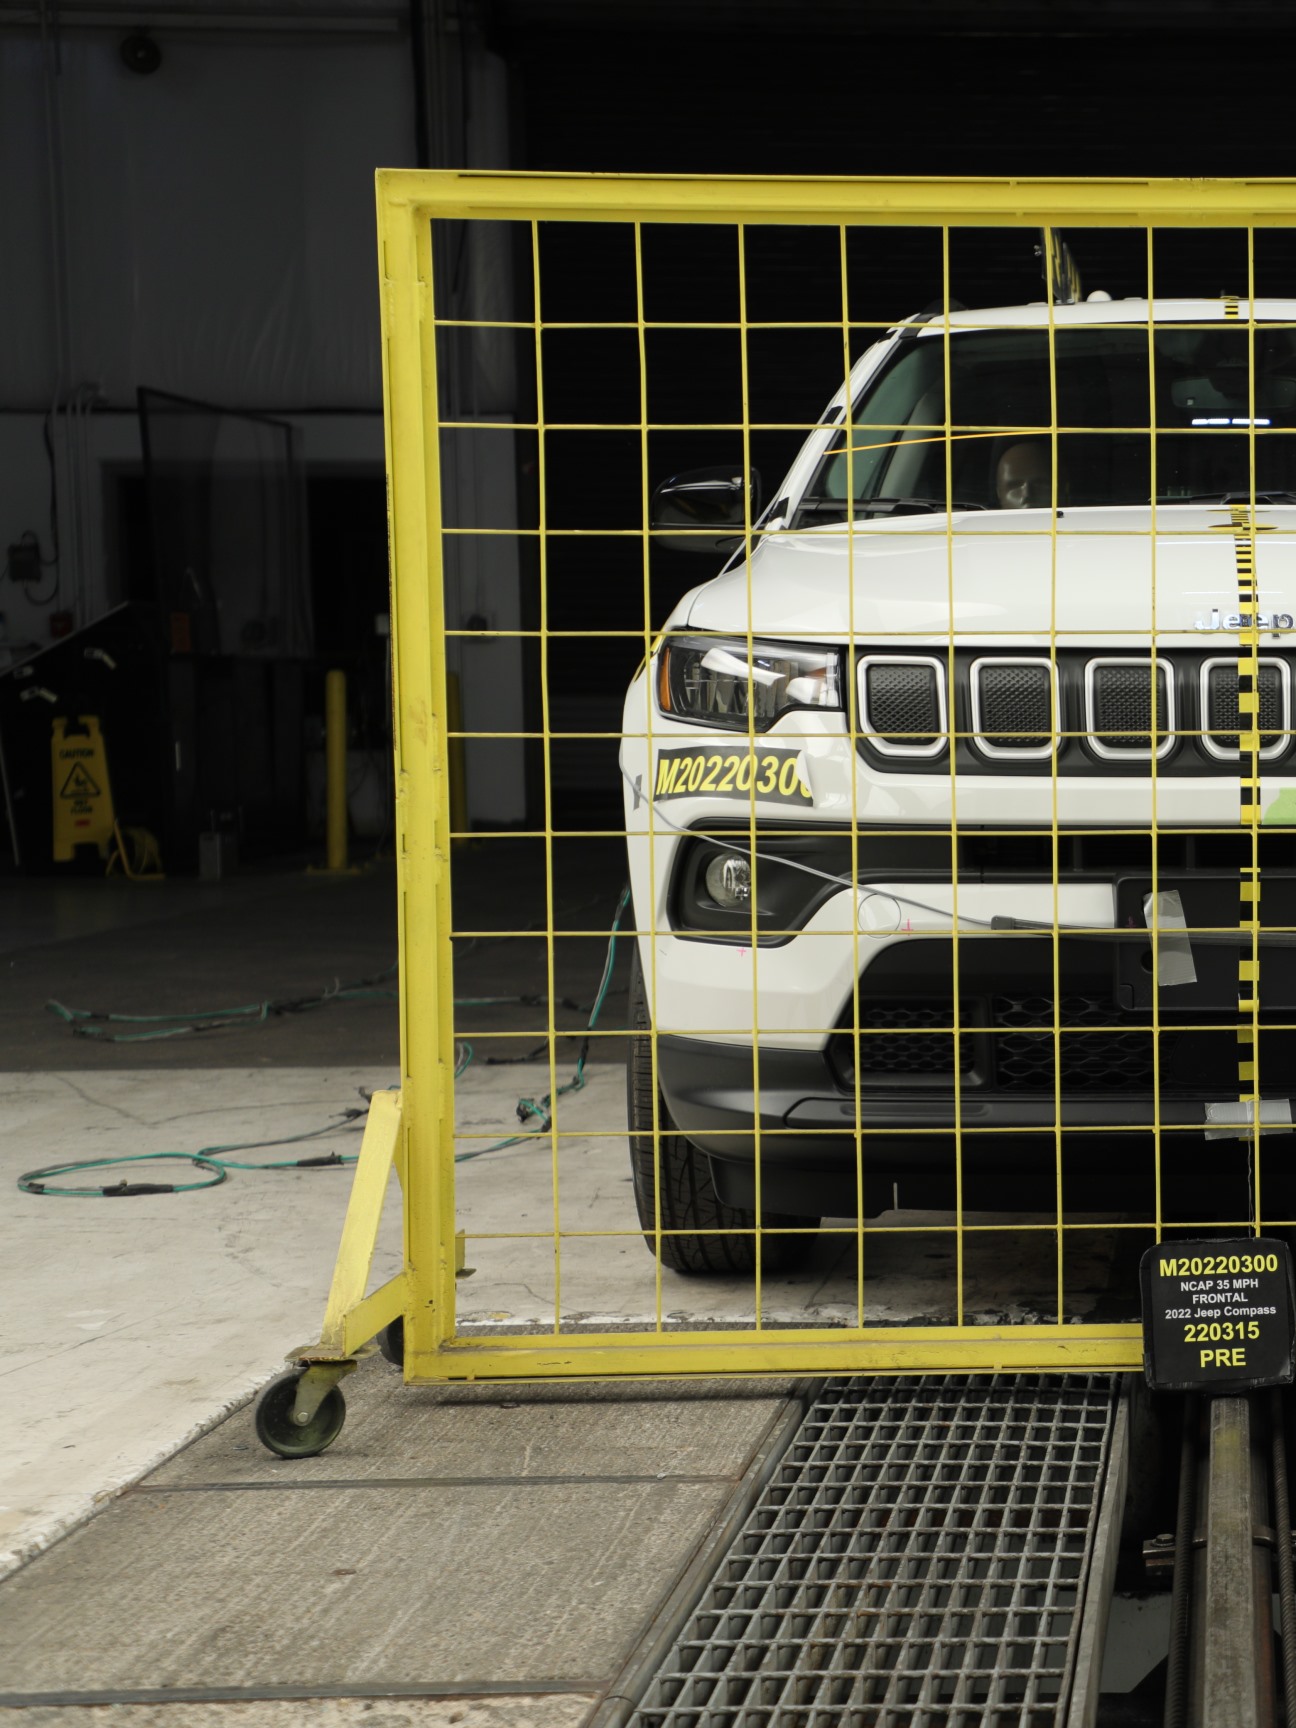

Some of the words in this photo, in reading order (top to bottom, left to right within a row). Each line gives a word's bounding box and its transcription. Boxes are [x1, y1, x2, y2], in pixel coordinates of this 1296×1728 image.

[60, 749, 94, 759] CAUTION
[656, 755, 812, 798] M2022030
[1159, 1254, 1278, 1277] M20220300
[1180, 1281, 1214, 1292] NCAP
[1216, 1279, 1230, 1290] 35
[1232, 1278, 1259, 1289] MPH
[1192, 1292, 1249, 1305] FRONTAL
[1165, 1308, 1192, 1319] 2022
[1193, 1308, 1221, 1319] Jeep
[1223, 1306, 1277, 1318] Compass
[1184, 1321, 1260, 1342] 220315
[1200, 1348, 1247, 1368] PRE
